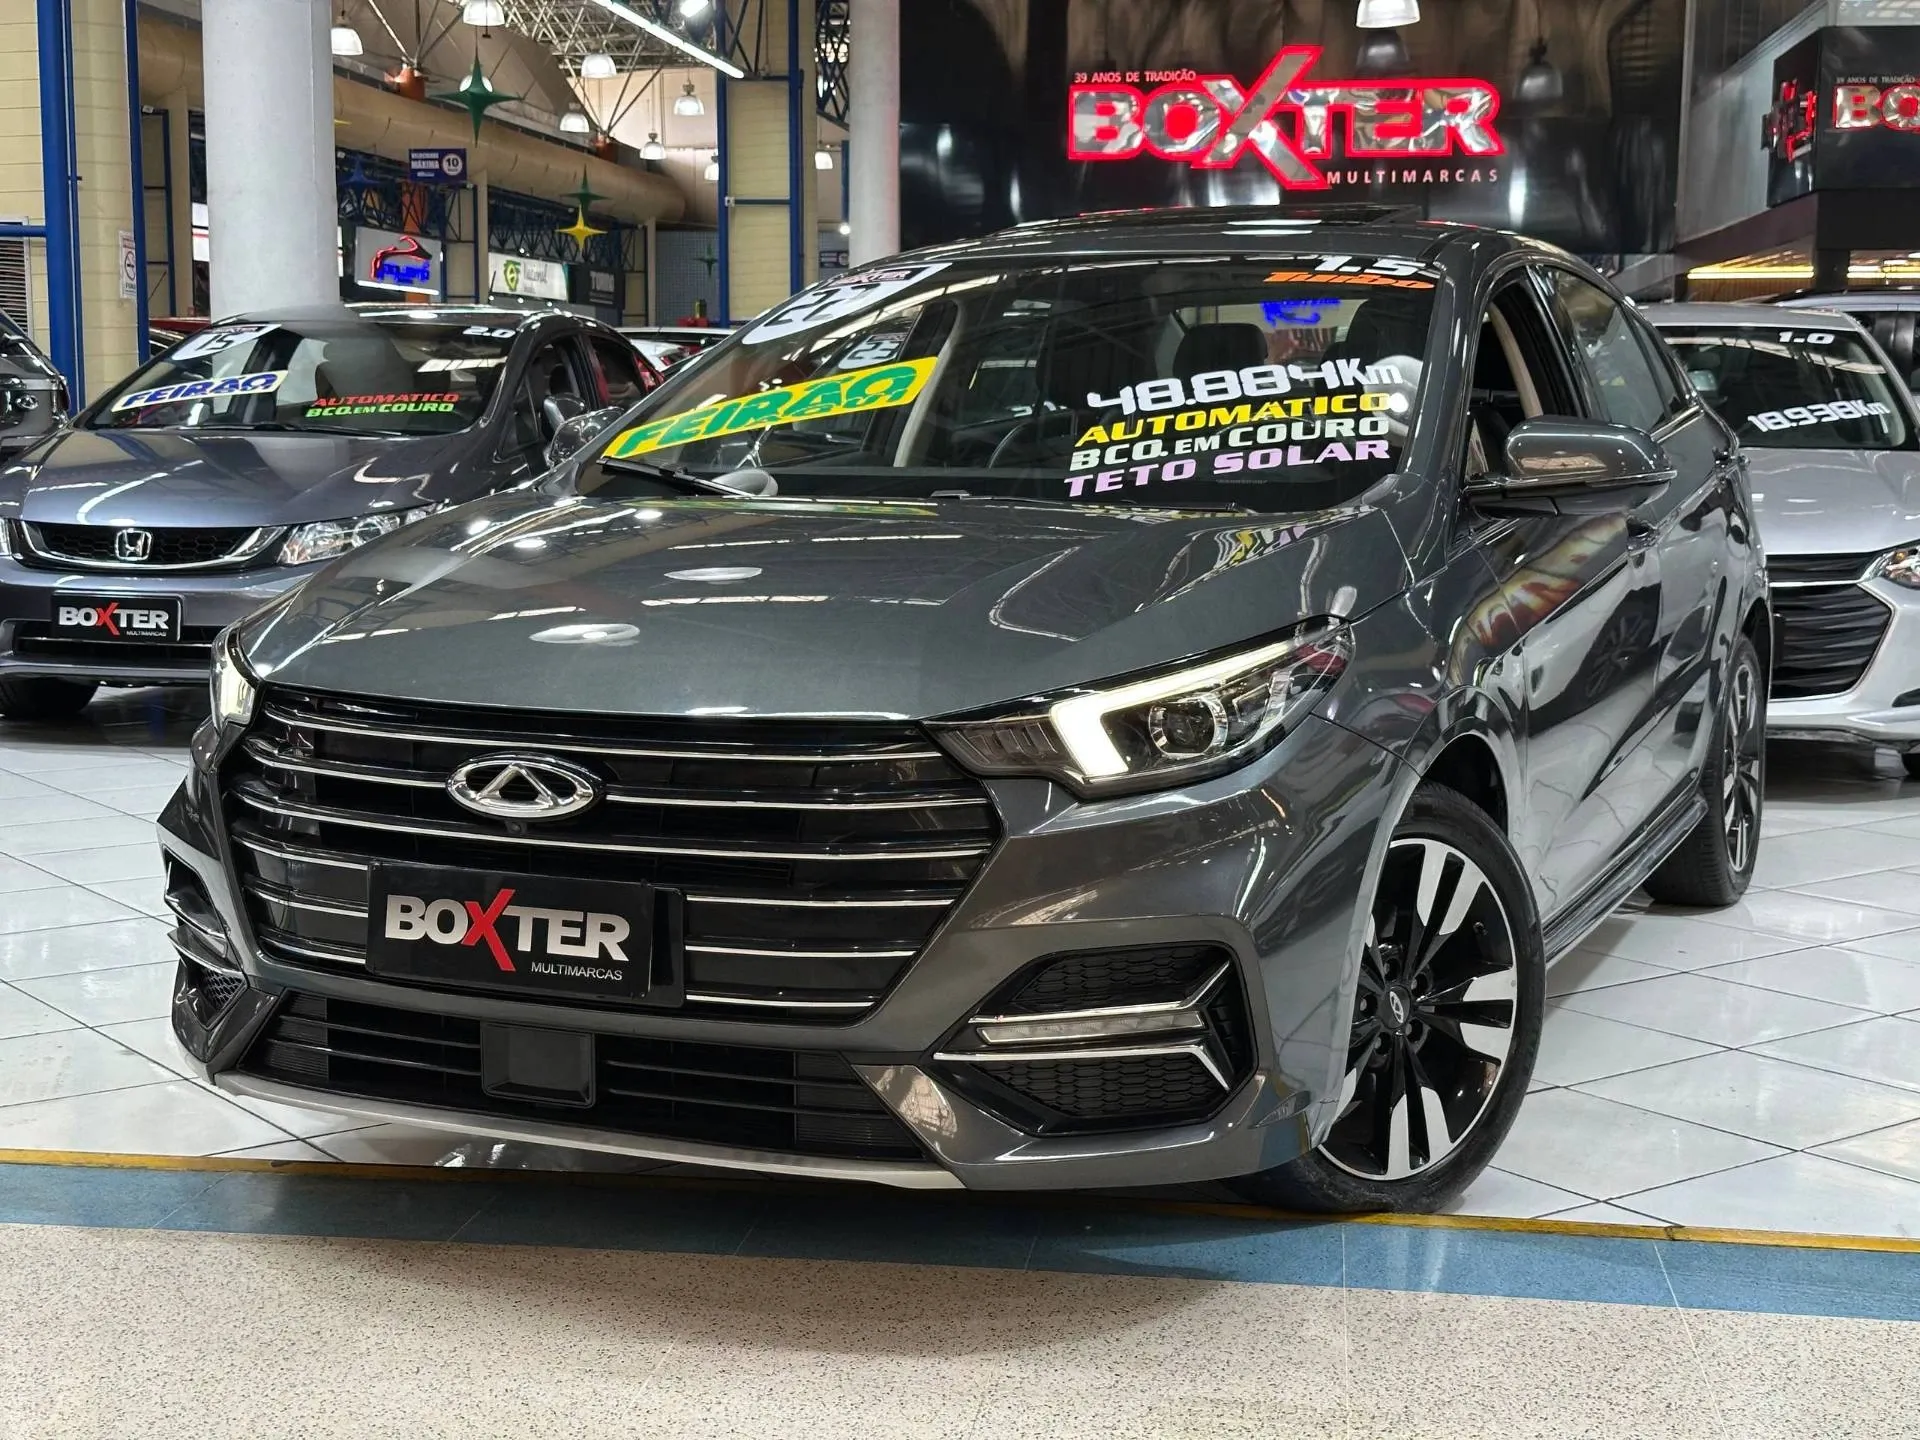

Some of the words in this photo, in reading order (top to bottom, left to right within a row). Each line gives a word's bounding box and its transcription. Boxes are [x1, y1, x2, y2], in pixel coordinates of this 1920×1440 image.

[1074, 72, 1088, 83] 39
[1091, 72, 1121, 83] ANOS
[1126, 71, 1140, 83] DE
[1144, 68, 1197, 84] TRADIÇÃO
[1068, 44, 1506, 190] BOXTER
[446, 157, 459, 168] 10
[1326, 168, 1501, 185] MULTIMARCAS
[1314, 255, 1427, 276] 1.5
[463, 325, 516, 338] 2.0
[1778, 331, 1836, 345] 1.0
[353, 406, 376, 414] EM
[378, 402, 455, 413] COURO
[1174, 434, 1220, 455] EM
[1228, 416, 1390, 448] COURO
[1064, 459, 1197, 498] TETO
[1213, 439, 1390, 475] SOLAR
[58, 602, 169, 635] BOXTER
[384, 888, 631, 972] BOXTER
[530, 960, 623, 982] MULTIMARCAS
